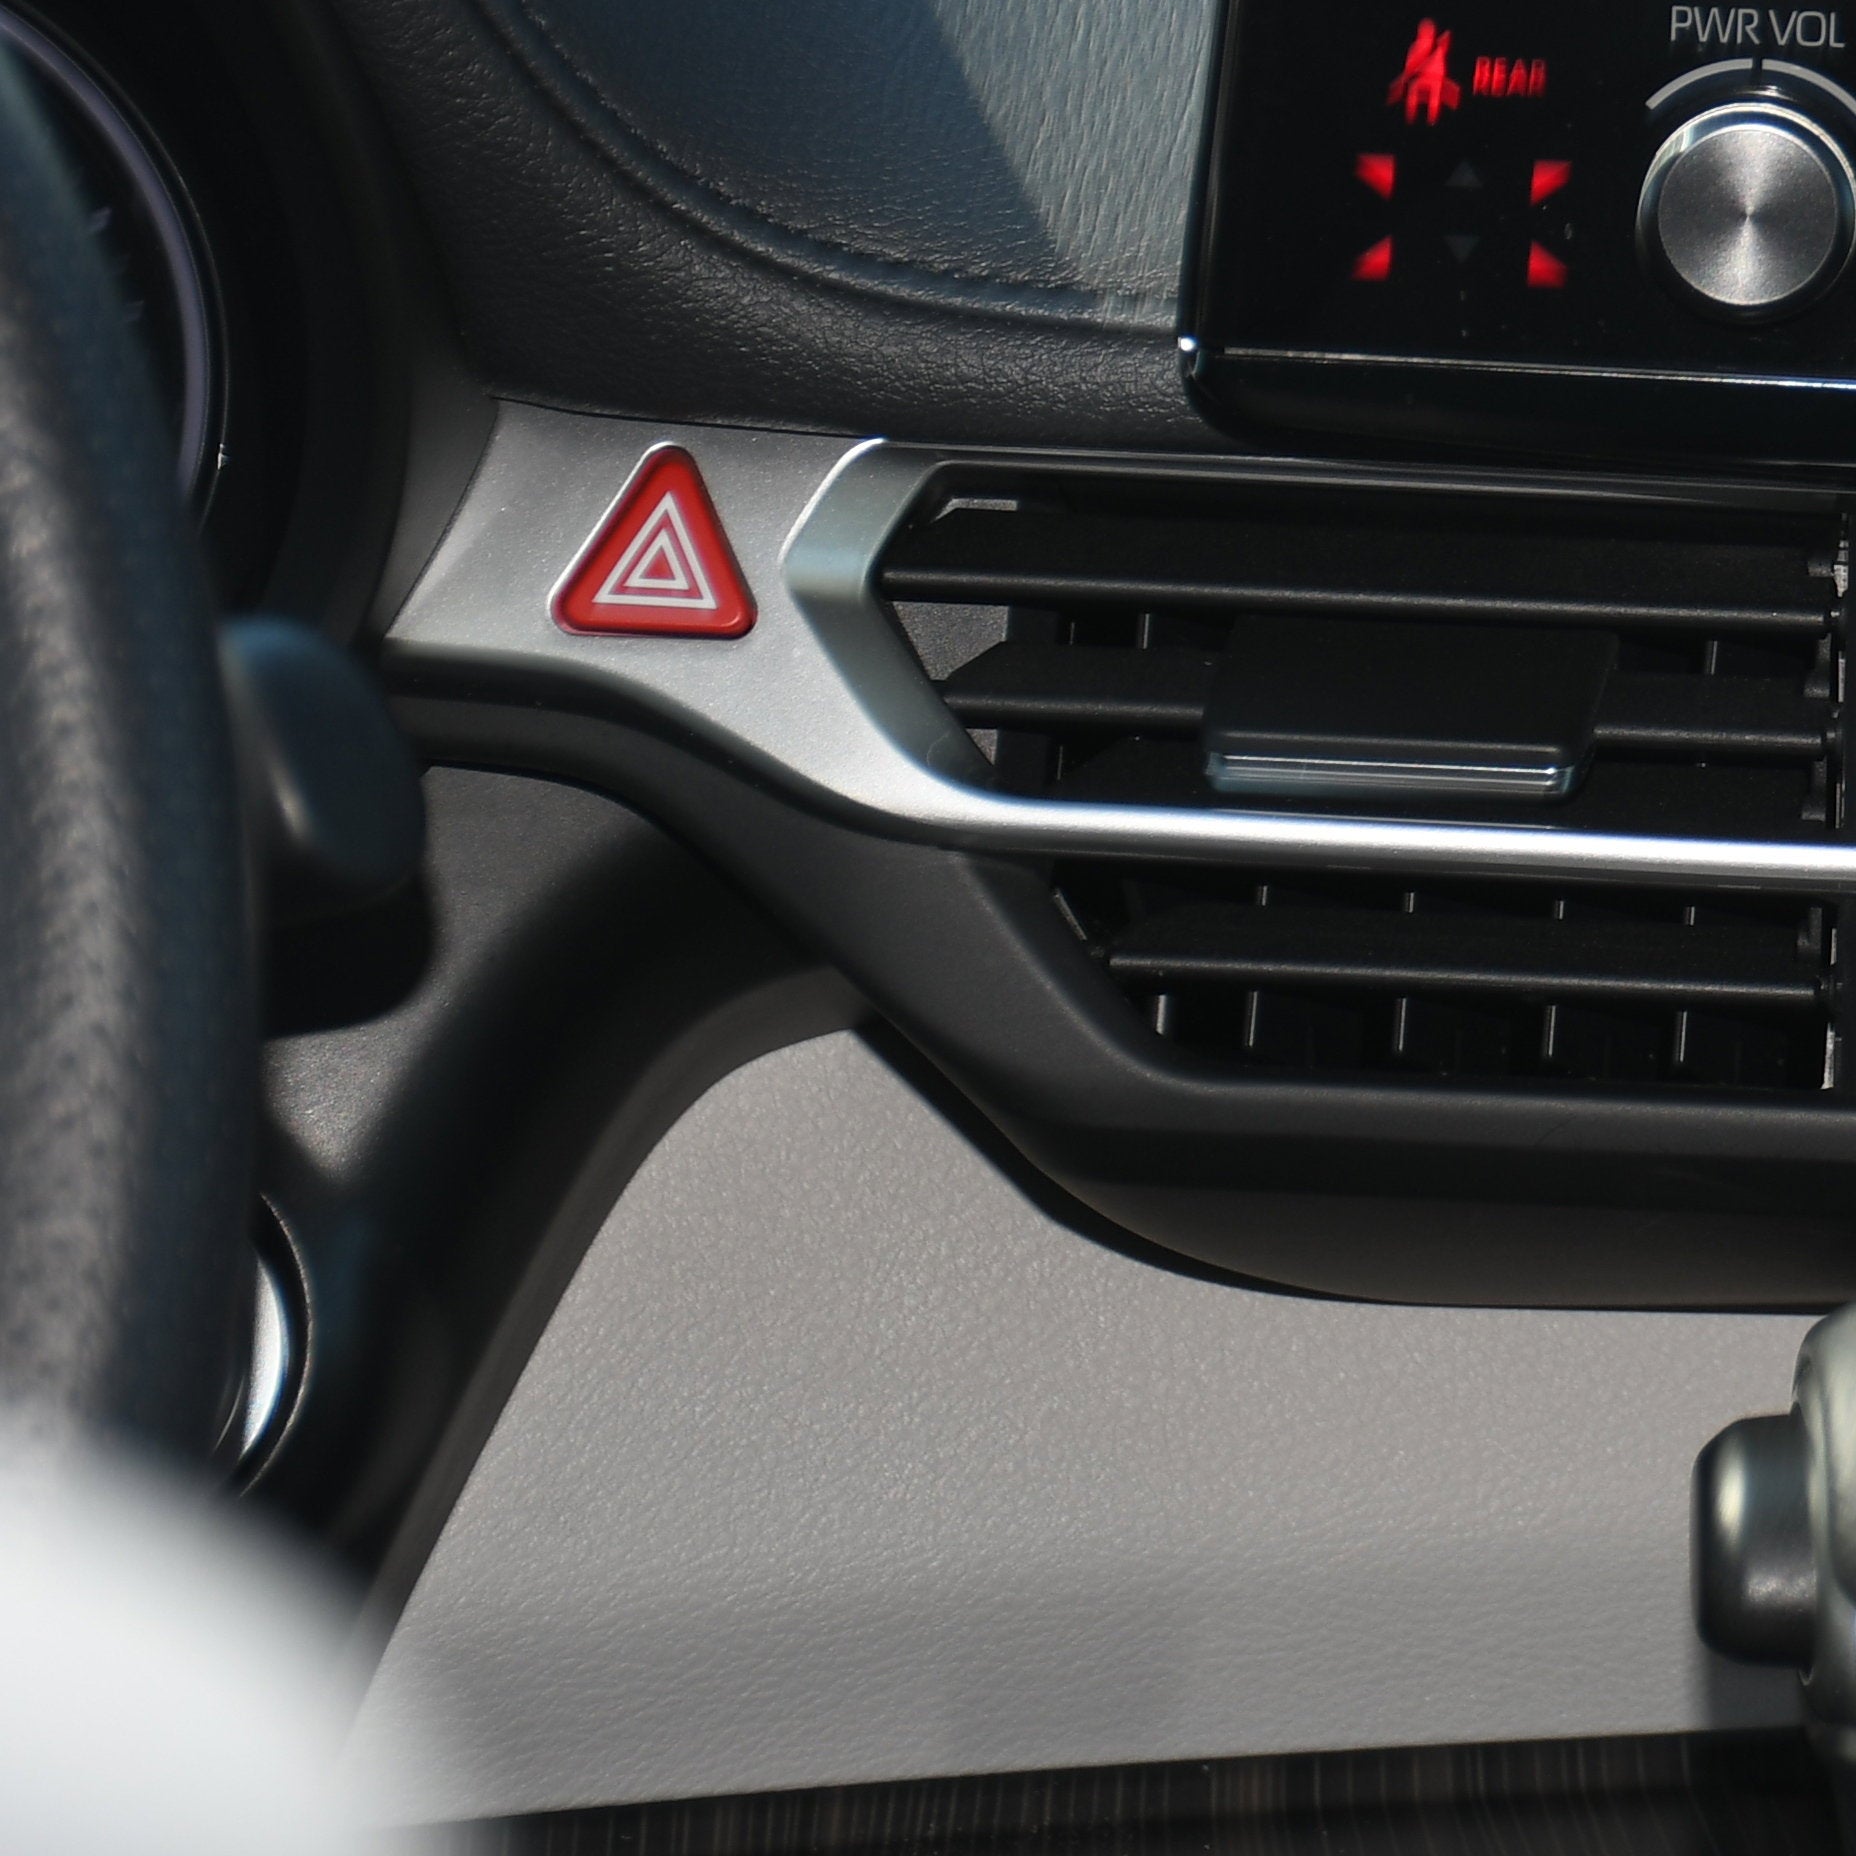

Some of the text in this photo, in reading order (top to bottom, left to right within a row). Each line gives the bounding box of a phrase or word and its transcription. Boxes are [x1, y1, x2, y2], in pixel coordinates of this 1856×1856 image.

[1670, 4, 1845, 50] PWR VOL
[1472, 55, 1547, 98] REAR
